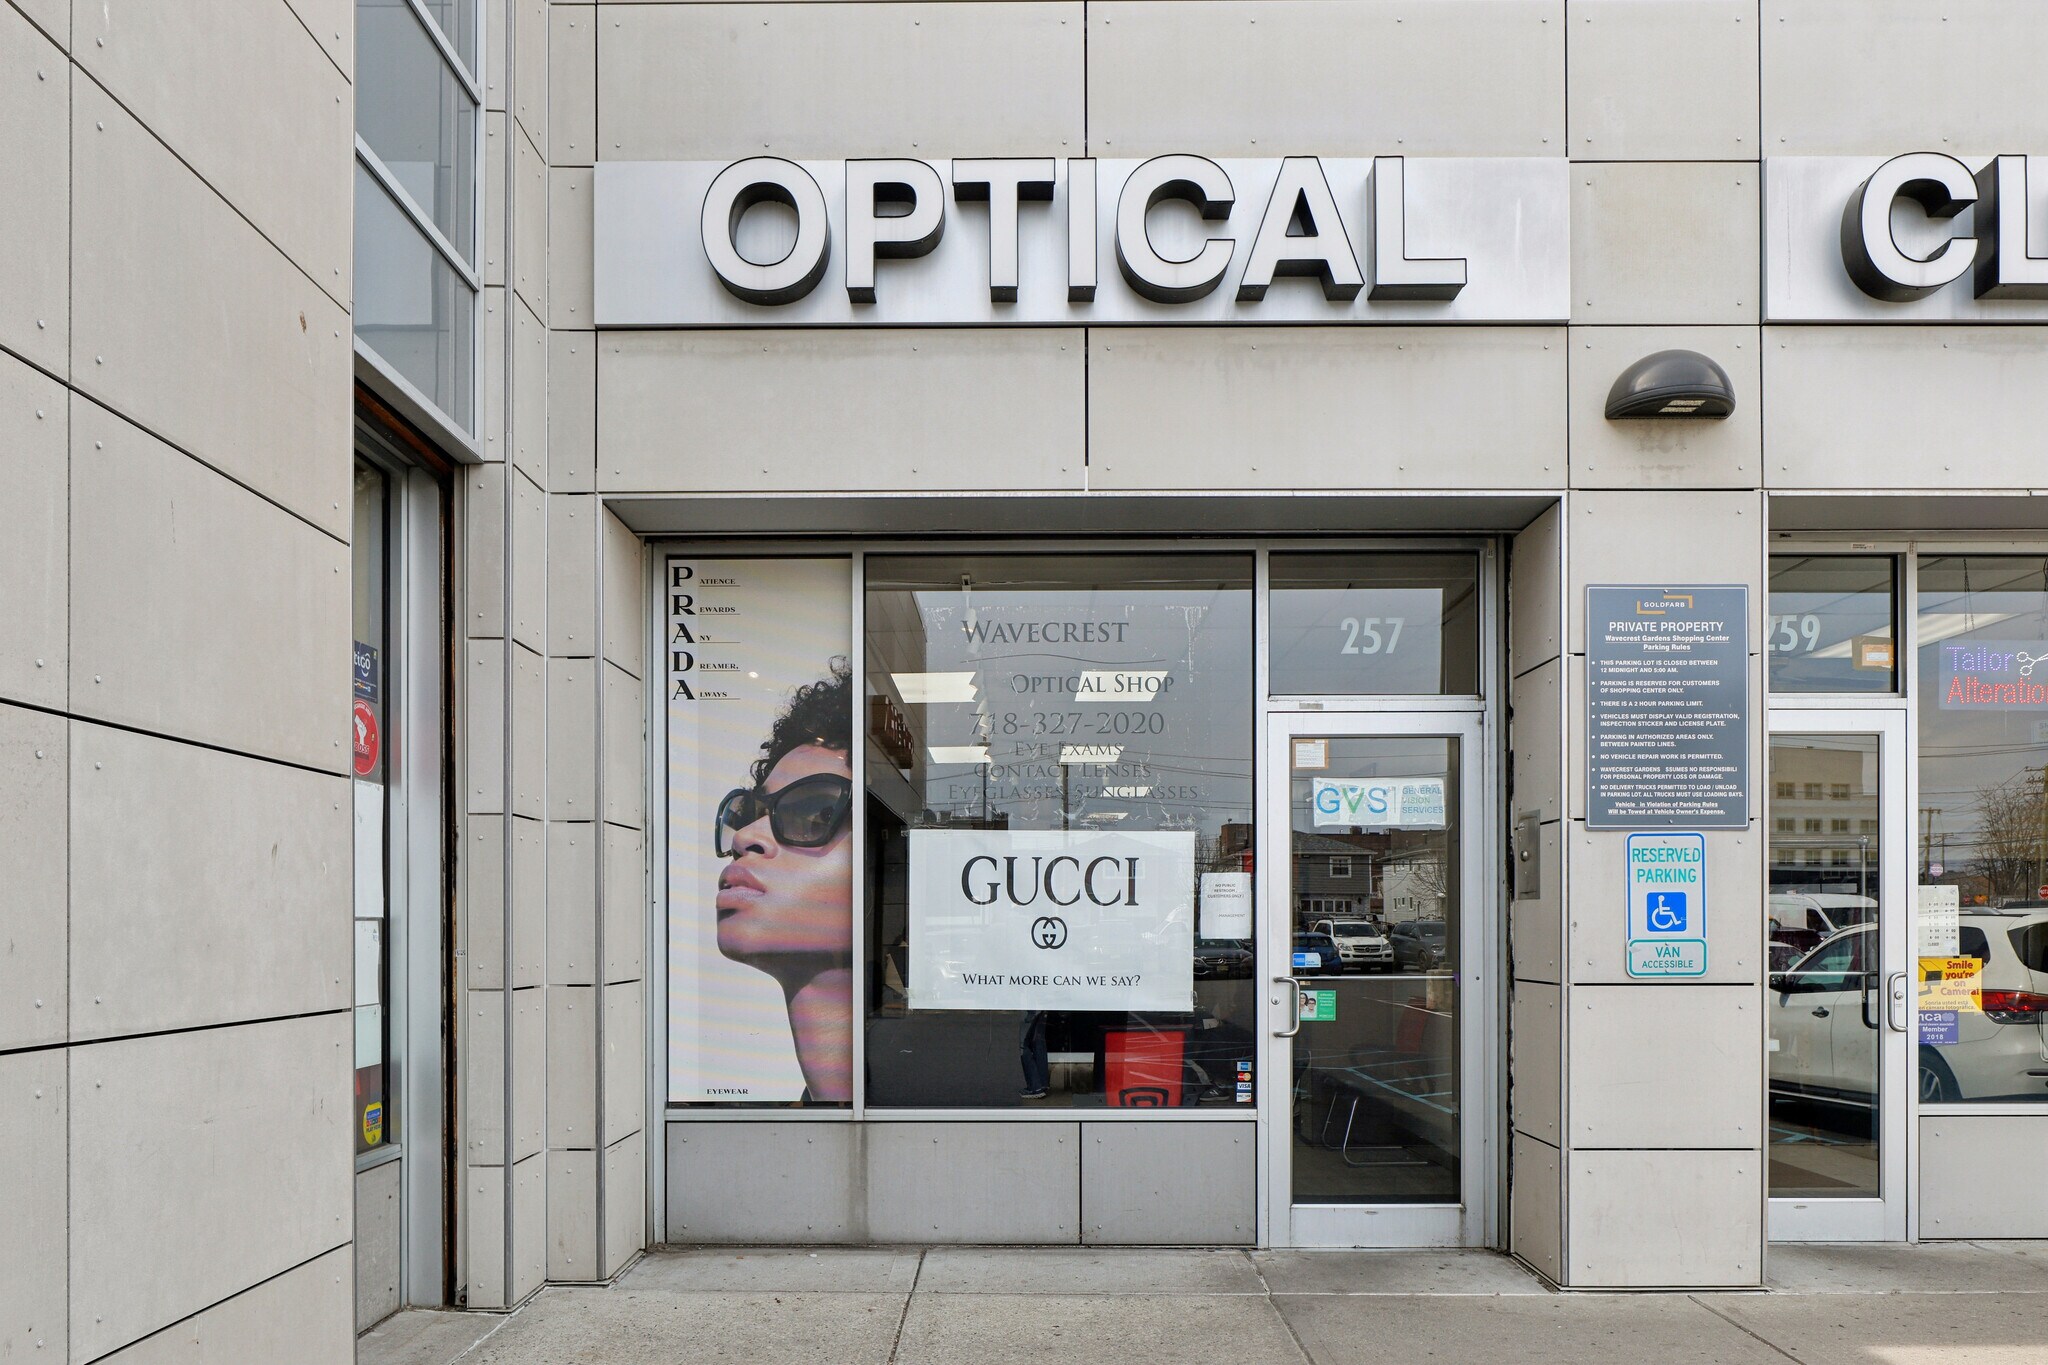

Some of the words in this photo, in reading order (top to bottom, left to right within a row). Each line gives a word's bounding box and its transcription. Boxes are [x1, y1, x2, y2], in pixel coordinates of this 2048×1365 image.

[701, 154, 1467, 306] OPTICAL
[961, 620, 1129, 643] WAVECREST
[1609, 622, 1657, 631] PRIVATE
[1661, 622, 1724, 631] PROPERTY
[1340, 617, 1404, 655] 257
[1672, 635, 1704, 643] Shopping
[1643, 644, 1670, 652] Parking
[1946, 646, 2014, 671] Tailor
[1011, 674, 1106, 693] OPTICAL
[1114, 673, 1174, 693] SHOP
[1946, 676, 2048, 704] Alteratio
[968, 712, 1164, 735] 718-327-2020
[1082, 762, 1151, 777] LENSES
[1402, 787, 1442, 795] GENERAL
[1316, 787, 1388, 814] GVS
[1402, 796, 1431, 804] VISION
[1402, 806, 1444, 814] SERVICES
[1632, 848, 1701, 863] RESERVED
[961, 855, 1140, 907] GUCCI
[1637, 868, 1697, 883] PARKING
[1655, 947, 1680, 958] VAN
[1642, 960, 1694, 968] ACCESSIBLE
[1946, 961, 1973, 969] Smile
[962, 973, 1005, 985] WHAT
[1009, 975, 1048, 985] MORE
[1053, 975, 1081, 985] CAN
[1086, 976, 1106, 986] WE
[1111, 975, 1141, 986] SAY?
[1945, 970, 1974, 980] you're
